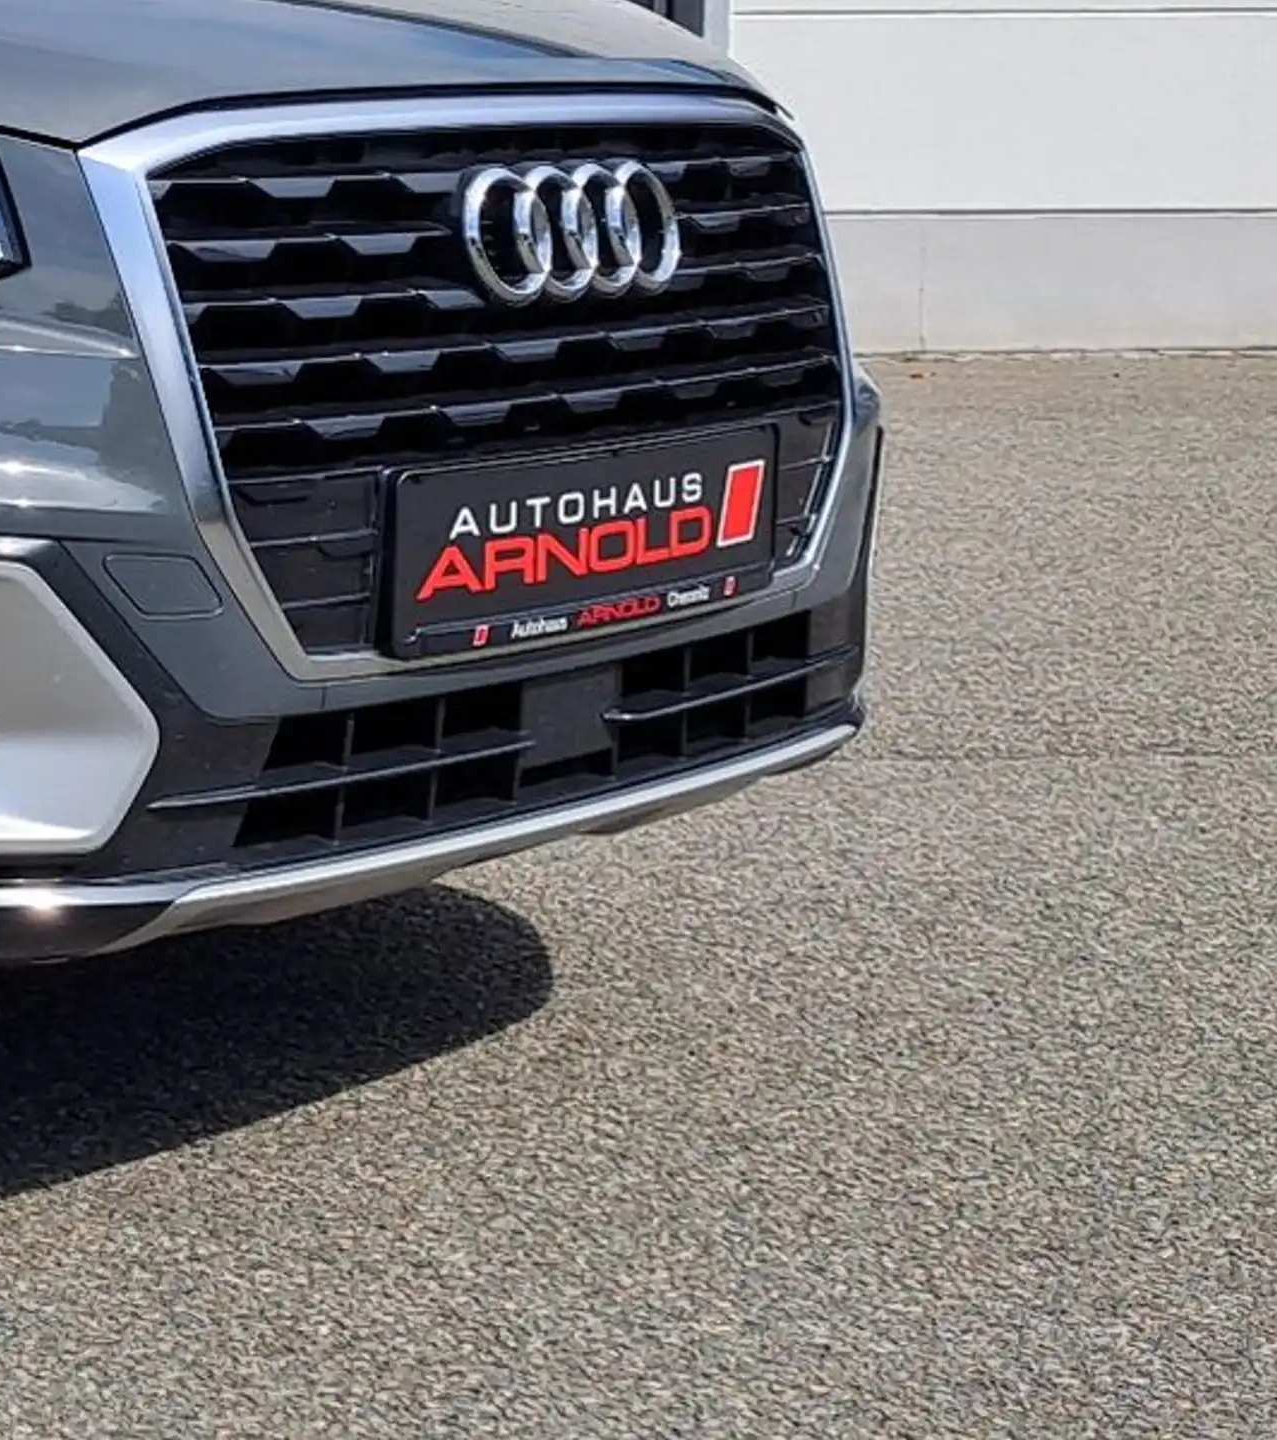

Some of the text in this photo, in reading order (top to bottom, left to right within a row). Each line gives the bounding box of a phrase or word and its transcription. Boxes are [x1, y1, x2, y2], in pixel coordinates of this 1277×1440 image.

[449, 472, 704, 541] AUTOHAUS
[414, 505, 714, 601] ARNOLD
[576, 595, 662, 628] ARNOLD
